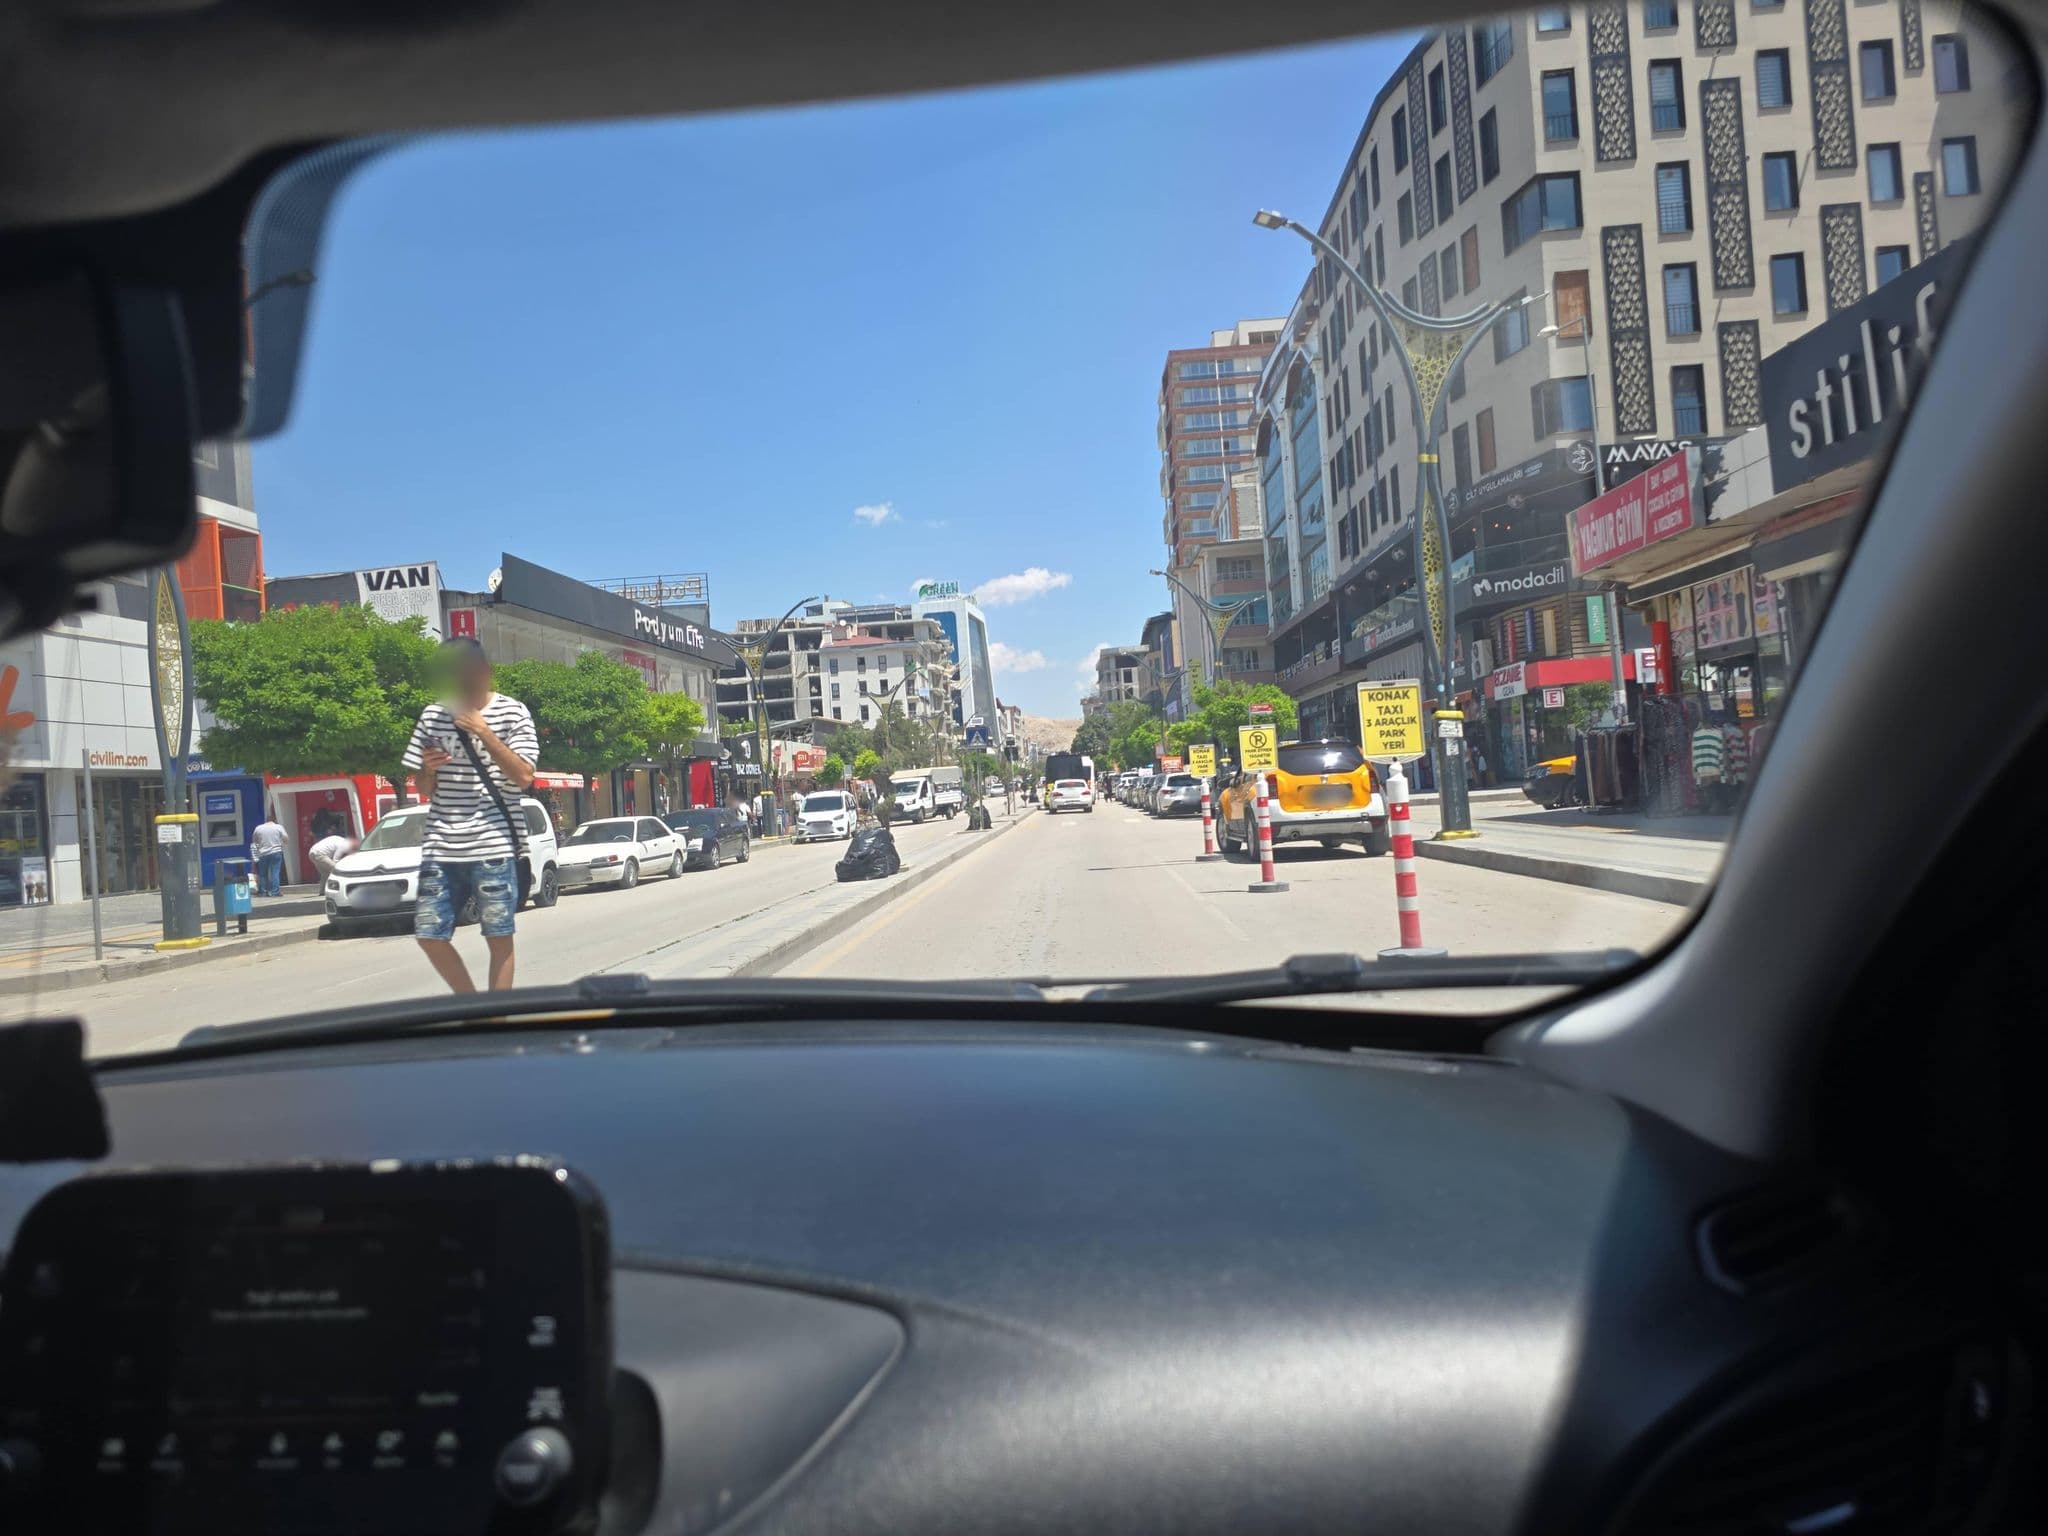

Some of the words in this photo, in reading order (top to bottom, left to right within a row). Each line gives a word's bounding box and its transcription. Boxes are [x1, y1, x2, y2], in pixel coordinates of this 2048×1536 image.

[1579, 513, 1616, 561] YAĞMUR
[1615, 492, 1643, 548] GİYİM
[363, 566, 430, 591] VAN
[1495, 566, 1565, 593] modadil
[634, 608, 684, 643] Podyum
[1368, 690, 1410, 703] KONAK
[1550, 692, 1559, 704] E
[1377, 705, 1404, 716] TAXI
[1366, 719, 1372, 727] 3
[1375, 716, 1417, 728] ARAÇLIK
[1379, 729, 1406, 739] PARK
[1382, 741, 1405, 751] YERİ
[91, 751, 149, 767] civilim.com
